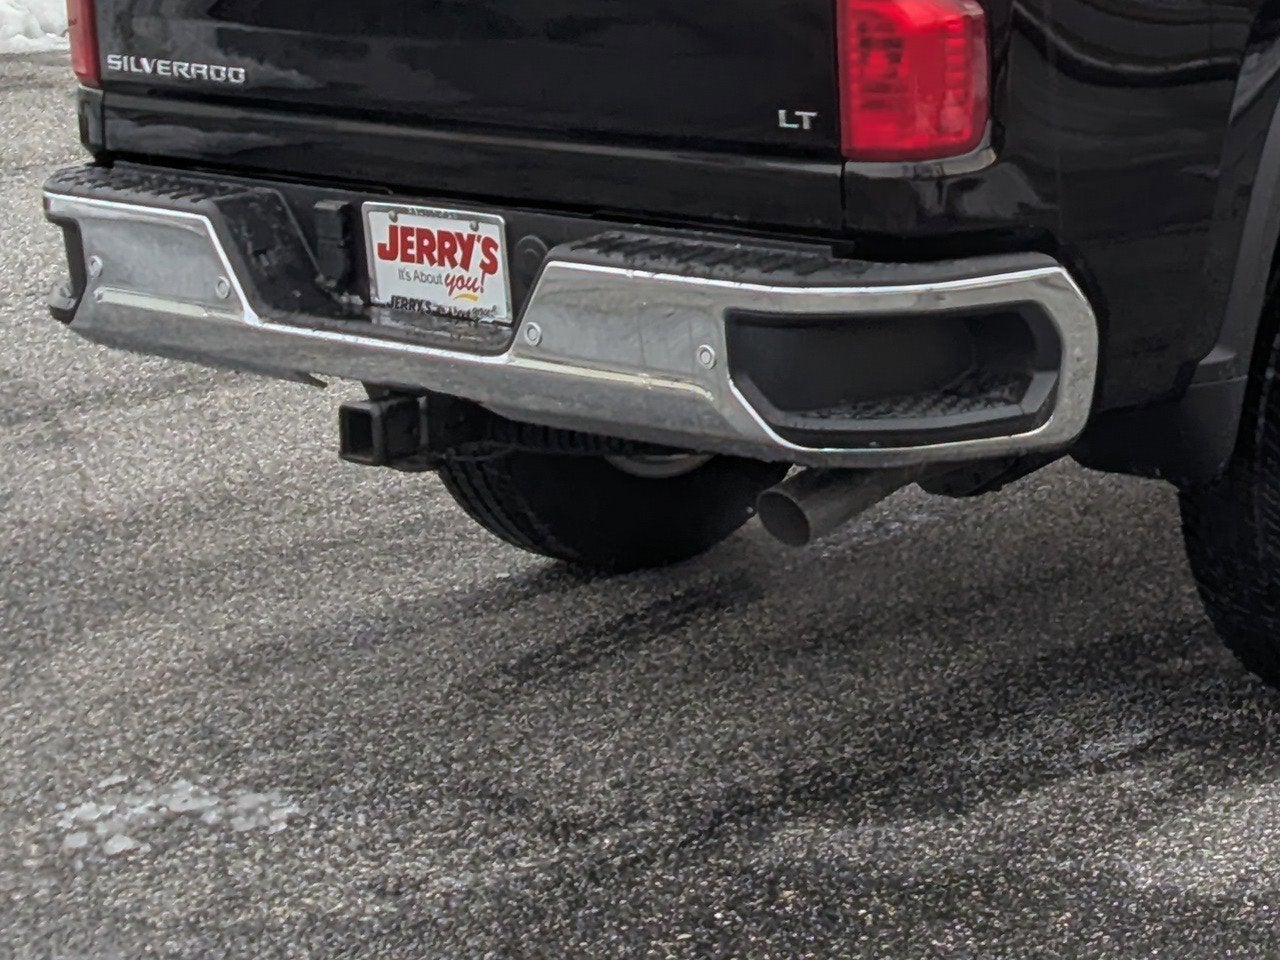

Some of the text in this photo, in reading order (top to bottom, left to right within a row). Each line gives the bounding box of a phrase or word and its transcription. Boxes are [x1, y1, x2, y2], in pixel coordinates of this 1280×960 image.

[106, 54, 246, 84] SILVERADO
[778, 109, 817, 130] LT
[377, 224, 499, 275] JERRY'S
[398, 269, 486, 296] It's About you!
